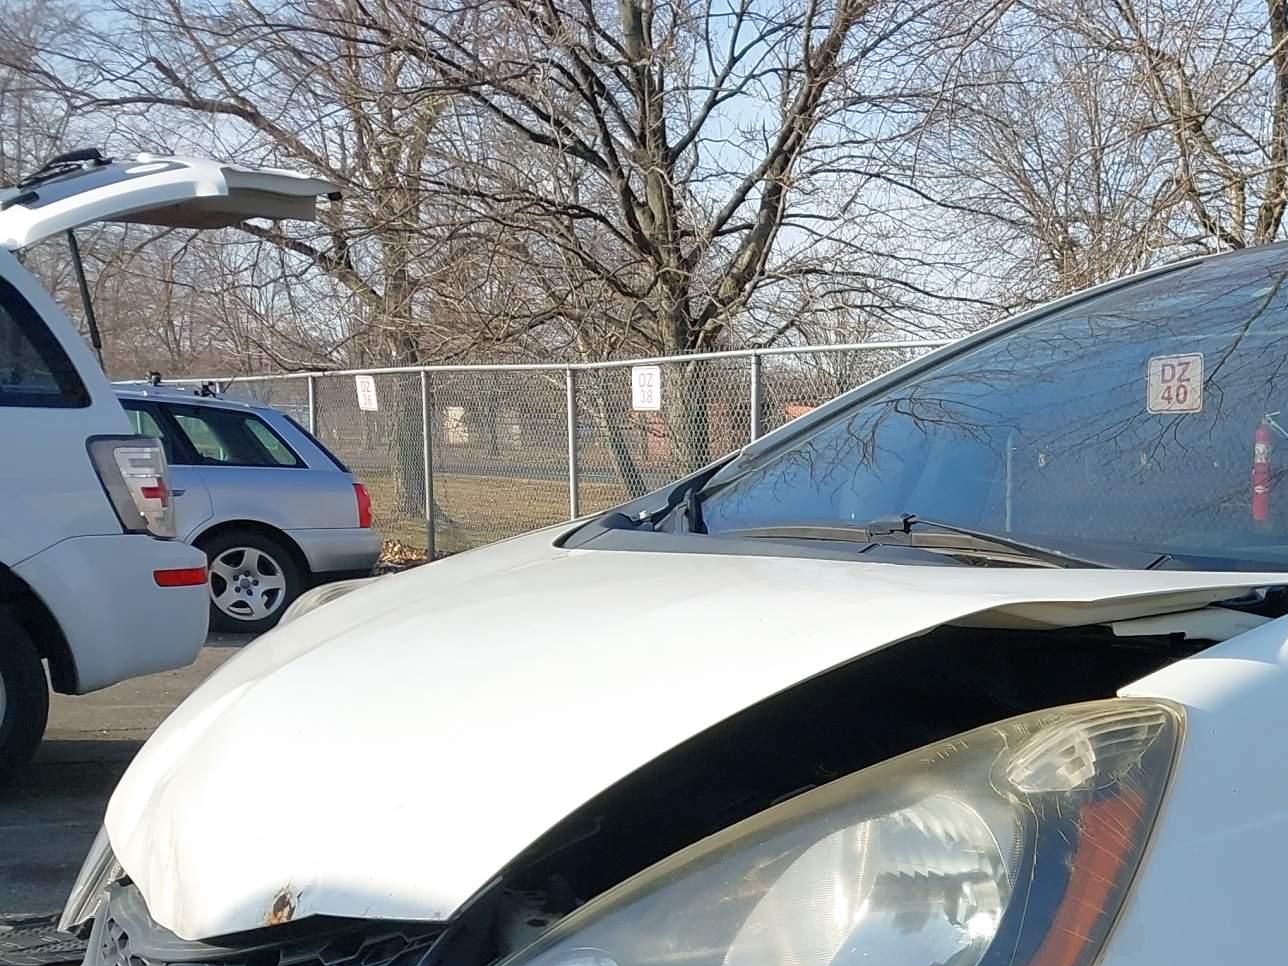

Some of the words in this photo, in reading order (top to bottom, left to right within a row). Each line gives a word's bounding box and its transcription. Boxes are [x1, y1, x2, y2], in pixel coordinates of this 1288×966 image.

[638, 372, 654, 388] DZ
[1160, 361, 1191, 384] DZ
[639, 388, 653, 404] 38
[1160, 384, 1188, 405] 40
